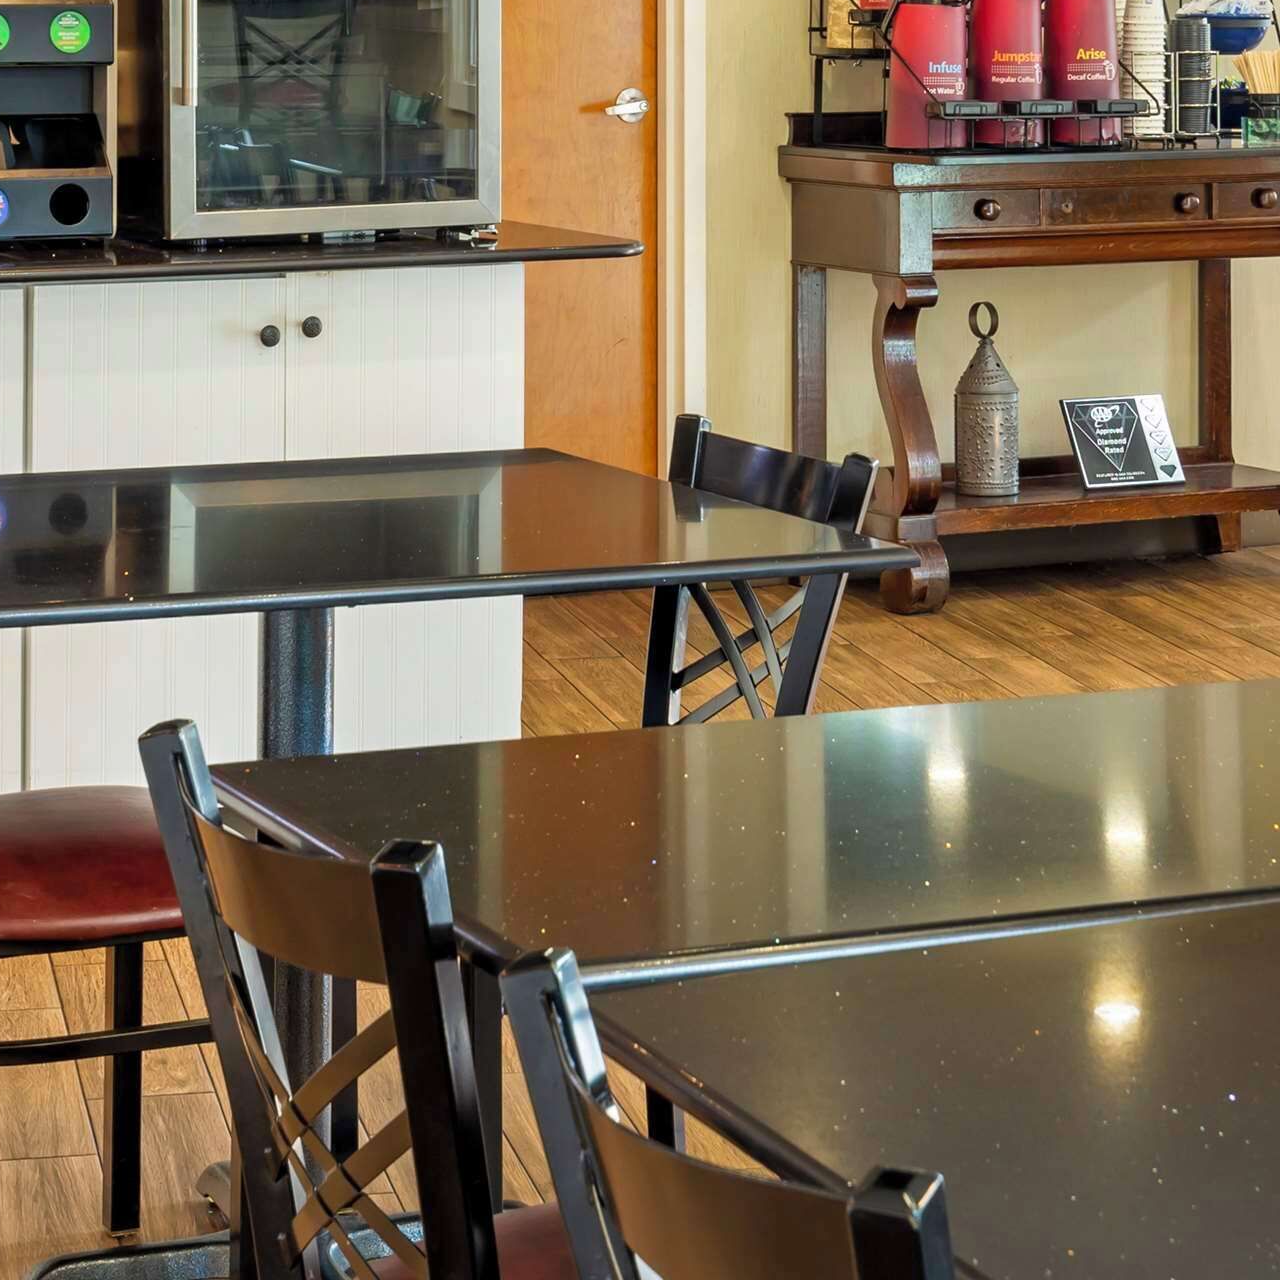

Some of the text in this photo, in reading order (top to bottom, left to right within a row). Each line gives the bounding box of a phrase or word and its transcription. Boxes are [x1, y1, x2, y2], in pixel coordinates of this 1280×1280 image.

[992, 50, 1042, 64] Jumpsta
[1076, 48, 1106, 60] Arise
[929, 61, 962, 73] Infuse
[991, 75, 1016, 84] Regular
[1067, 73, 1107, 81] Decaf Coffee
[937, 87, 956, 95] Water
[1095, 427, 1124, 437] Approved
[1097, 437, 1127, 446] Diamond
[1105, 446, 1125, 454] Rated
